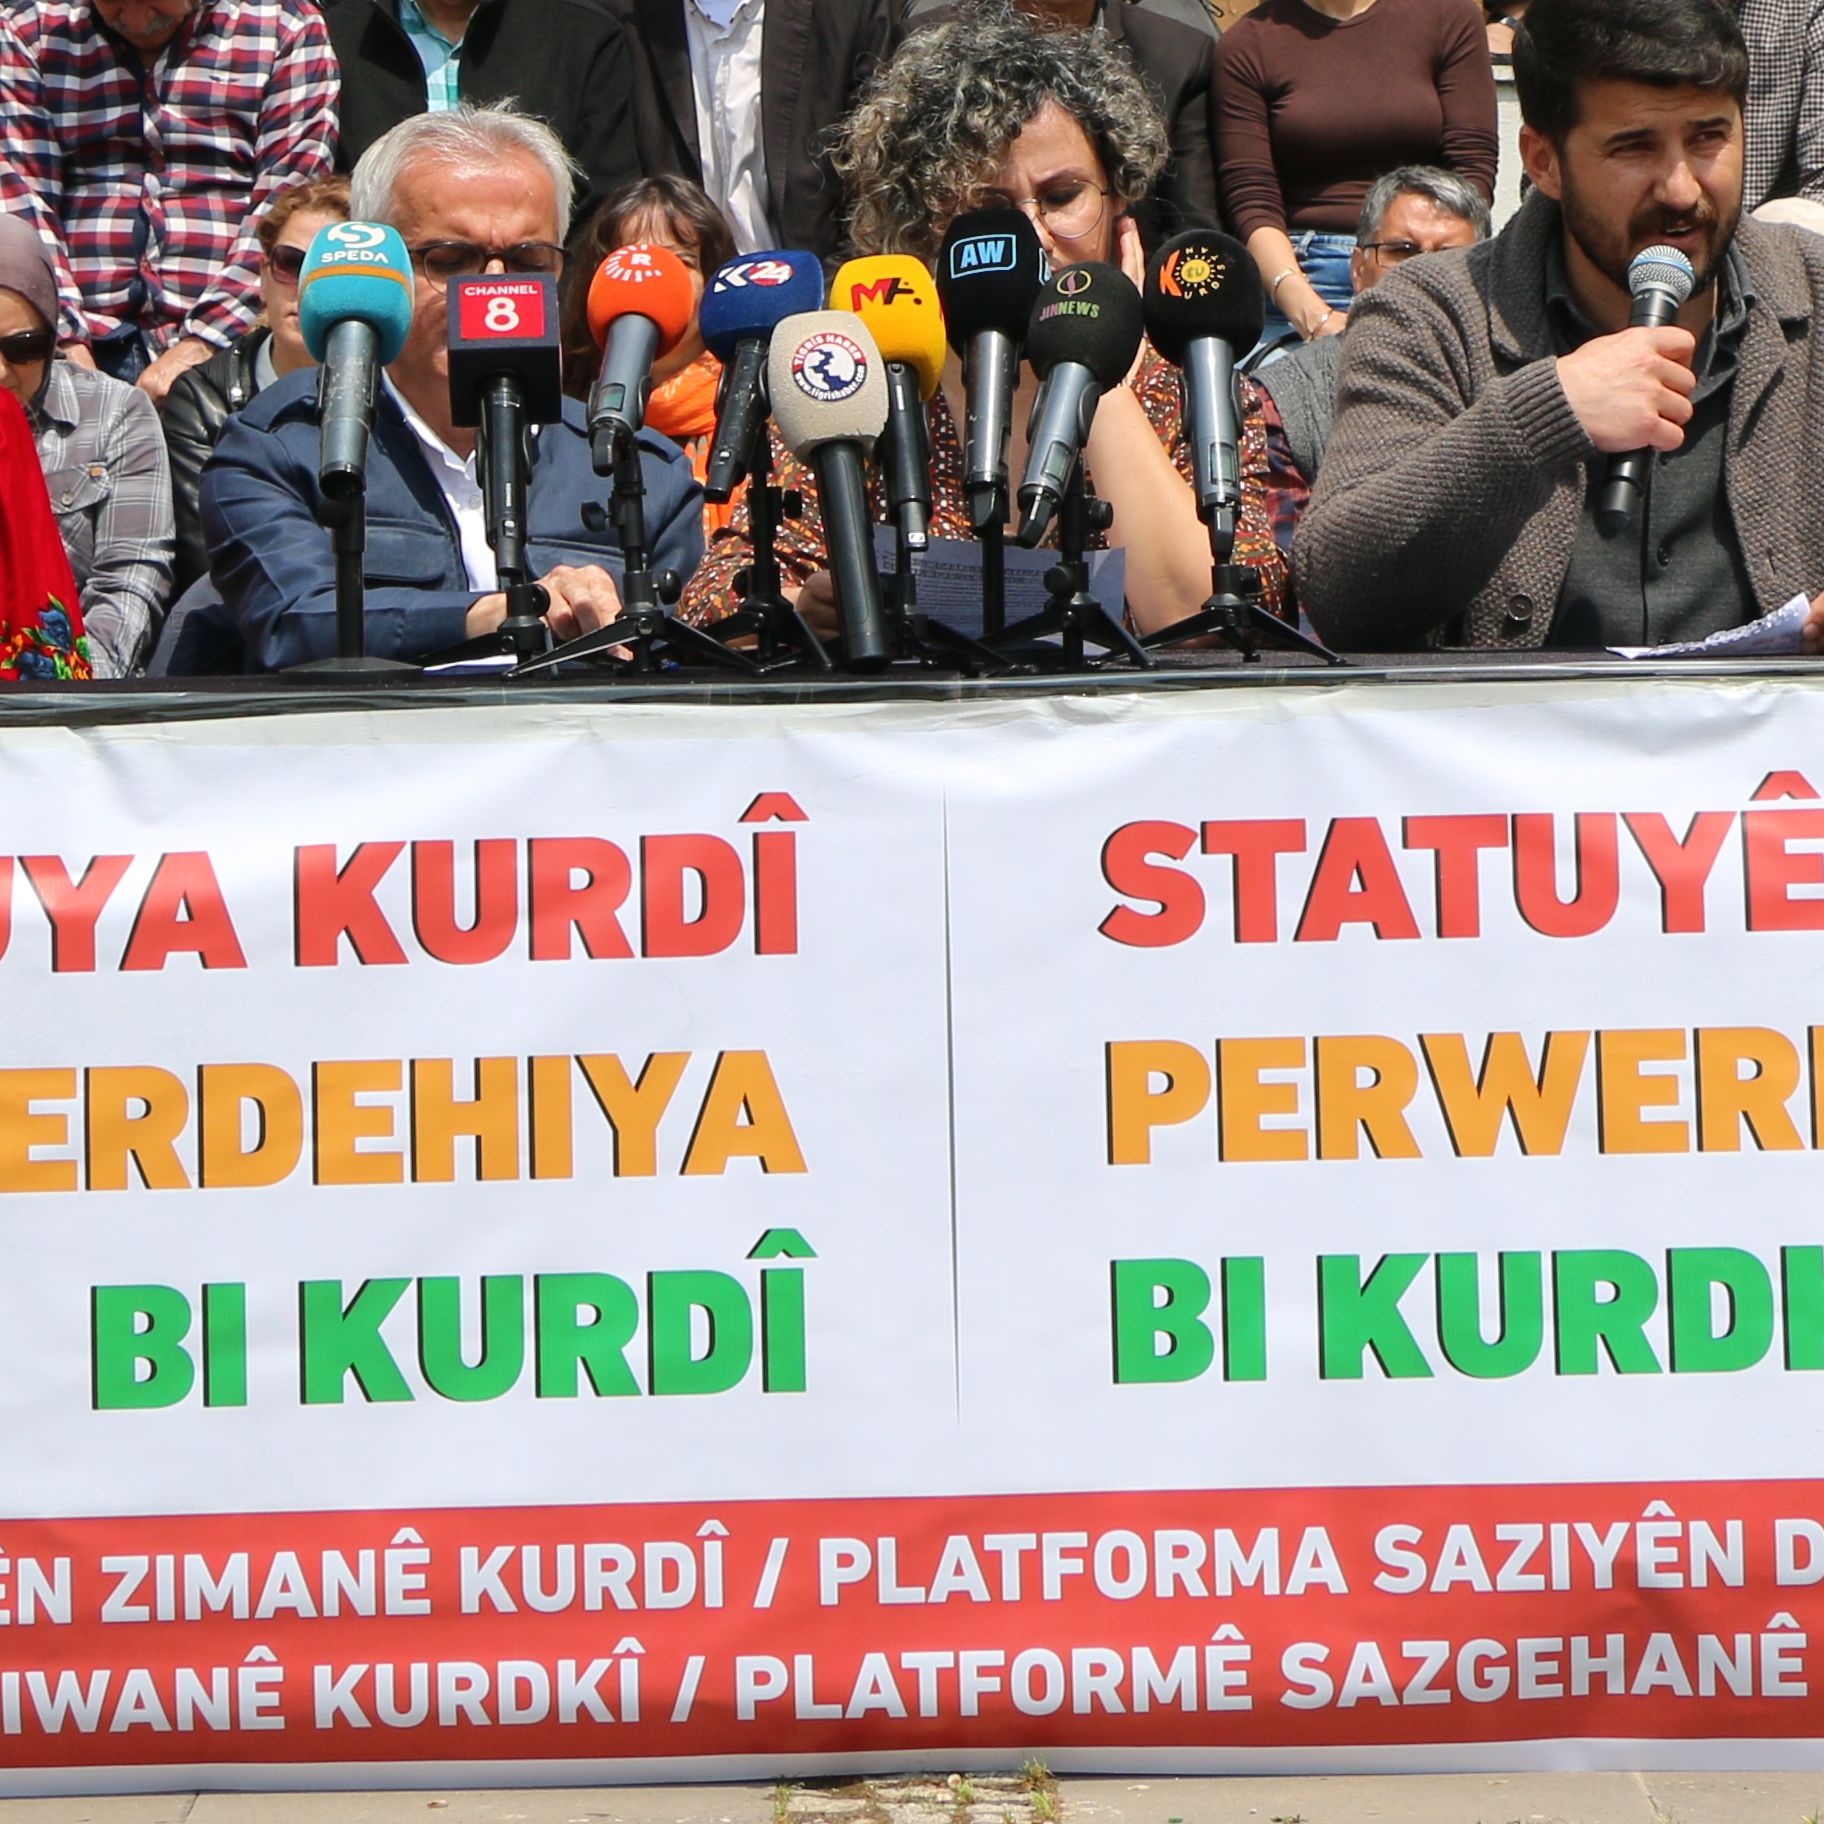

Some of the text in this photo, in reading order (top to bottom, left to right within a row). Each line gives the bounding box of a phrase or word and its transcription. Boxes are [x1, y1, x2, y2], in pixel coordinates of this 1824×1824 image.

[320, 250, 390, 264] SPEDA
[464, 284, 538, 296] CHANNEL
[960, 240, 1006, 269] AW
[484, 297, 520, 332] 8
[293, 791, 811, 967] KURDÎ
[91, 1227, 818, 1411] BI KURDÎ
[1110, 1256, 1267, 1384] BI
[100, 1526, 432, 1623] ZIMANÊ
[459, 1519, 730, 1614] KURDÎ
[753, 1537, 790, 1609] /
[818, 1525, 1350, 1606] PLATFORMA
[1372, 1499, 1745, 1594] SAZIYÊN
[313, 1636, 646, 1729] KURDKÎ
[670, 1655, 706, 1723] /
[735, 1623, 1253, 1721] PLATFORMÊ
[1279, 1611, 1809, 1710] SAZGEHANÊ
